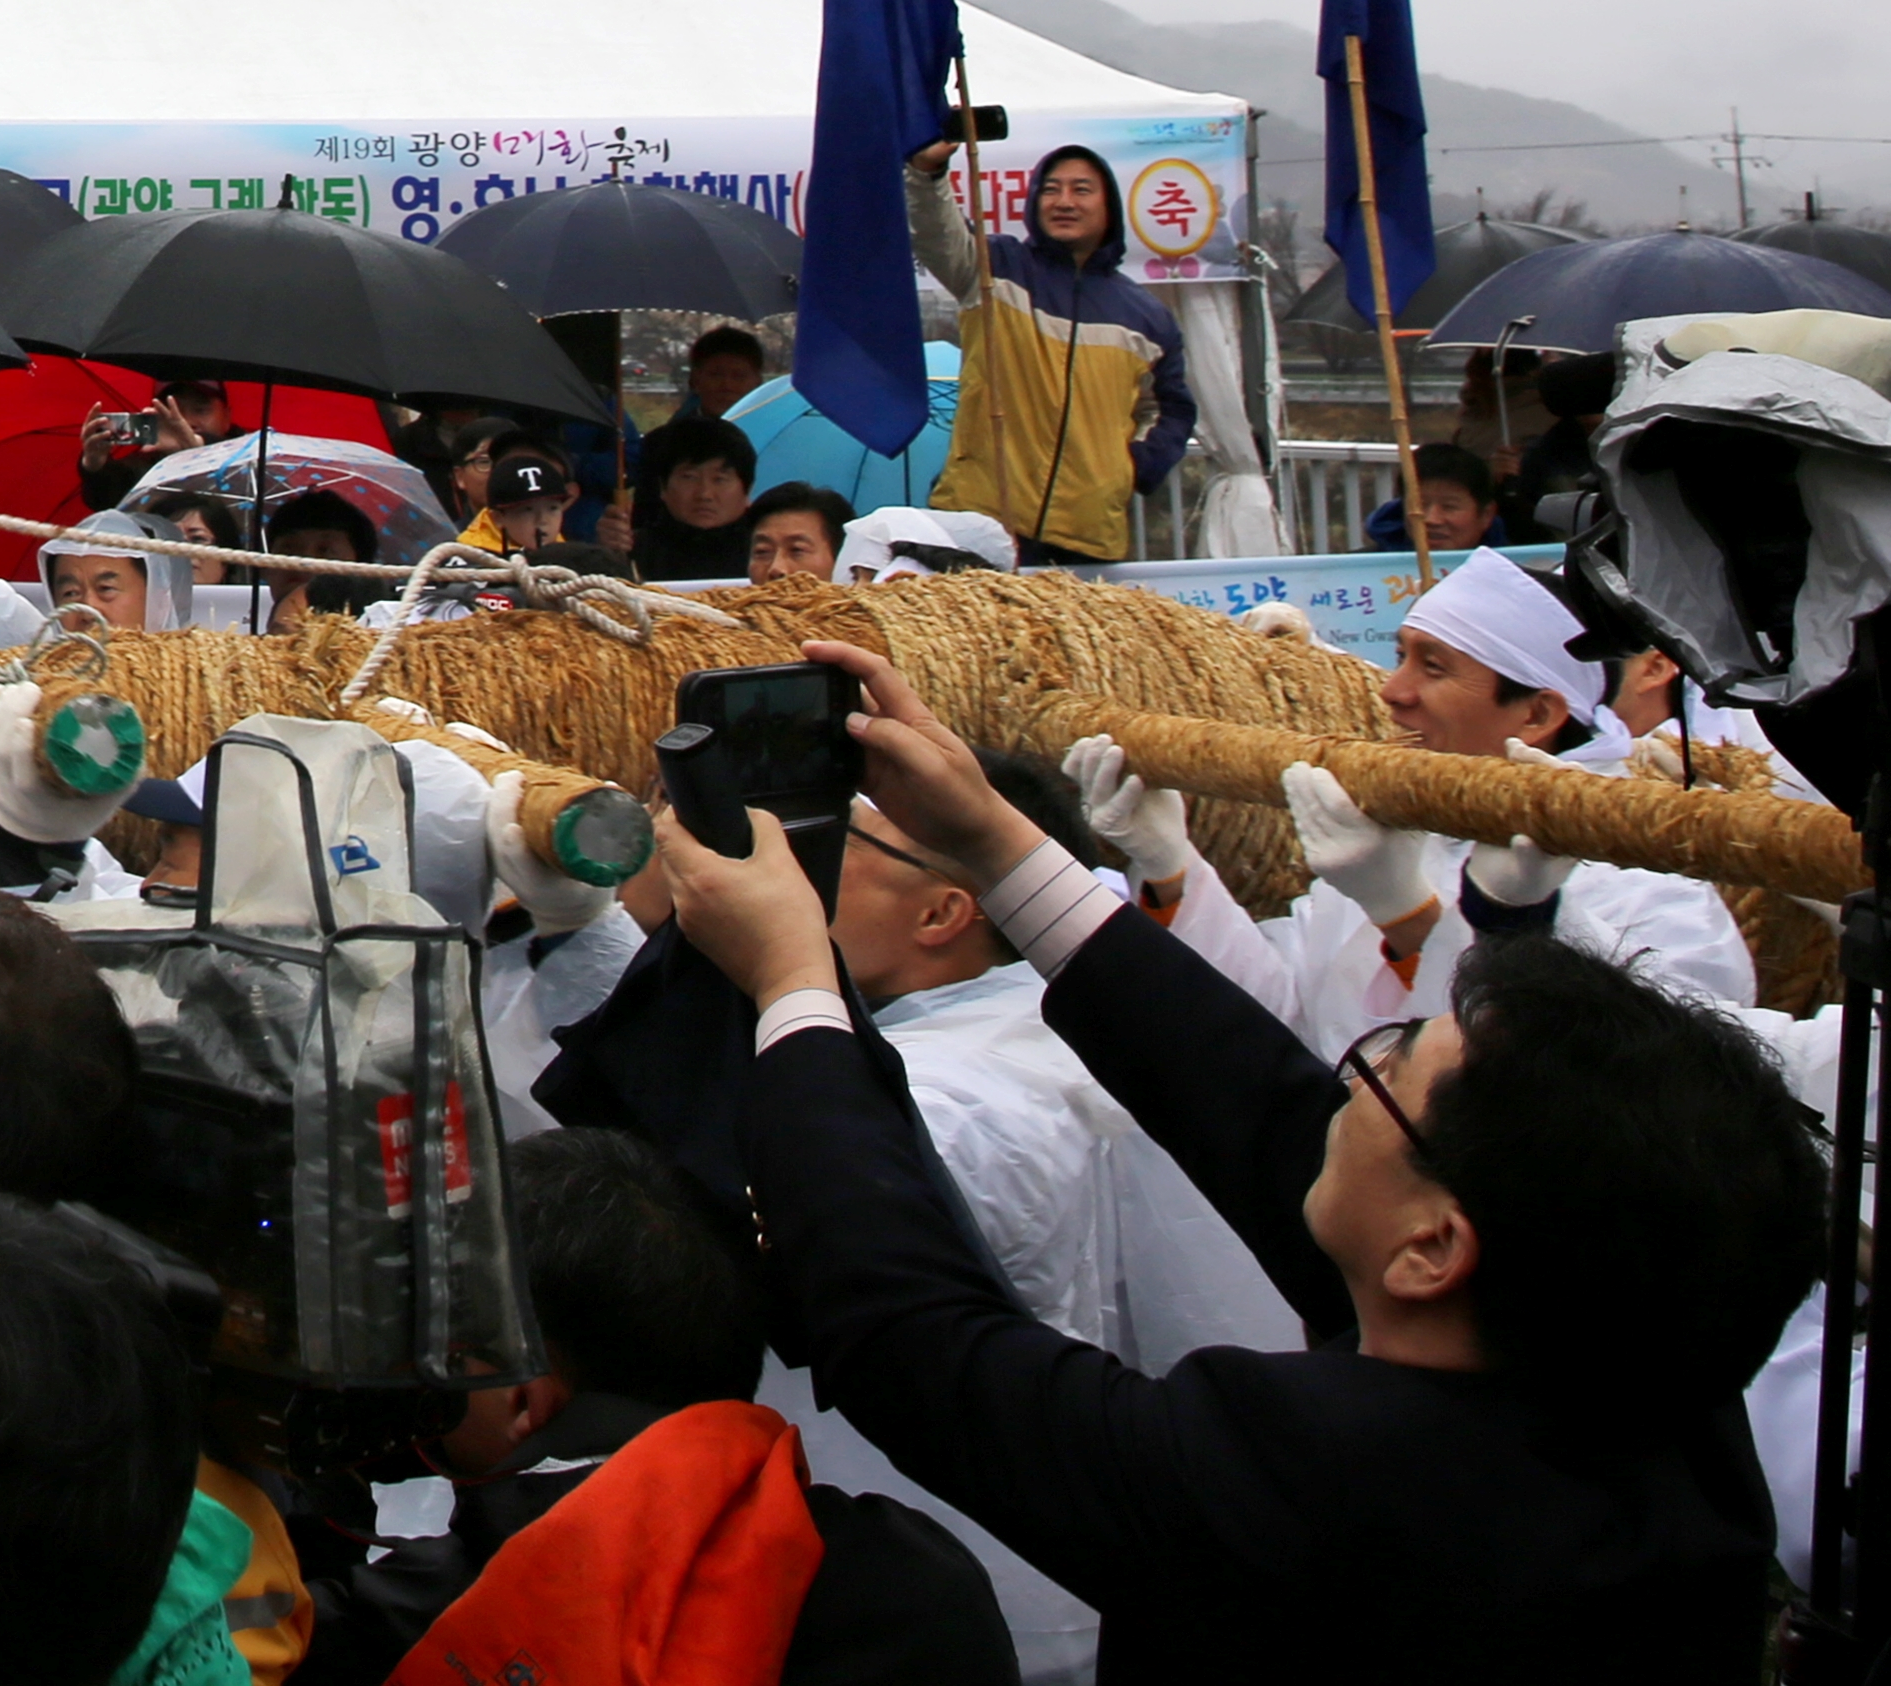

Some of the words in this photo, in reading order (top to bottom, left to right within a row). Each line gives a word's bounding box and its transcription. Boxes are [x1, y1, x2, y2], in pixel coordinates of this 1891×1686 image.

[314, 135, 396, 163] 제19회
[1146, 180, 1198, 238] 축
[517, 466, 542, 492] T
[1309, 584, 1376, 615] 새로운
[1329, 629, 1361, 644] New
